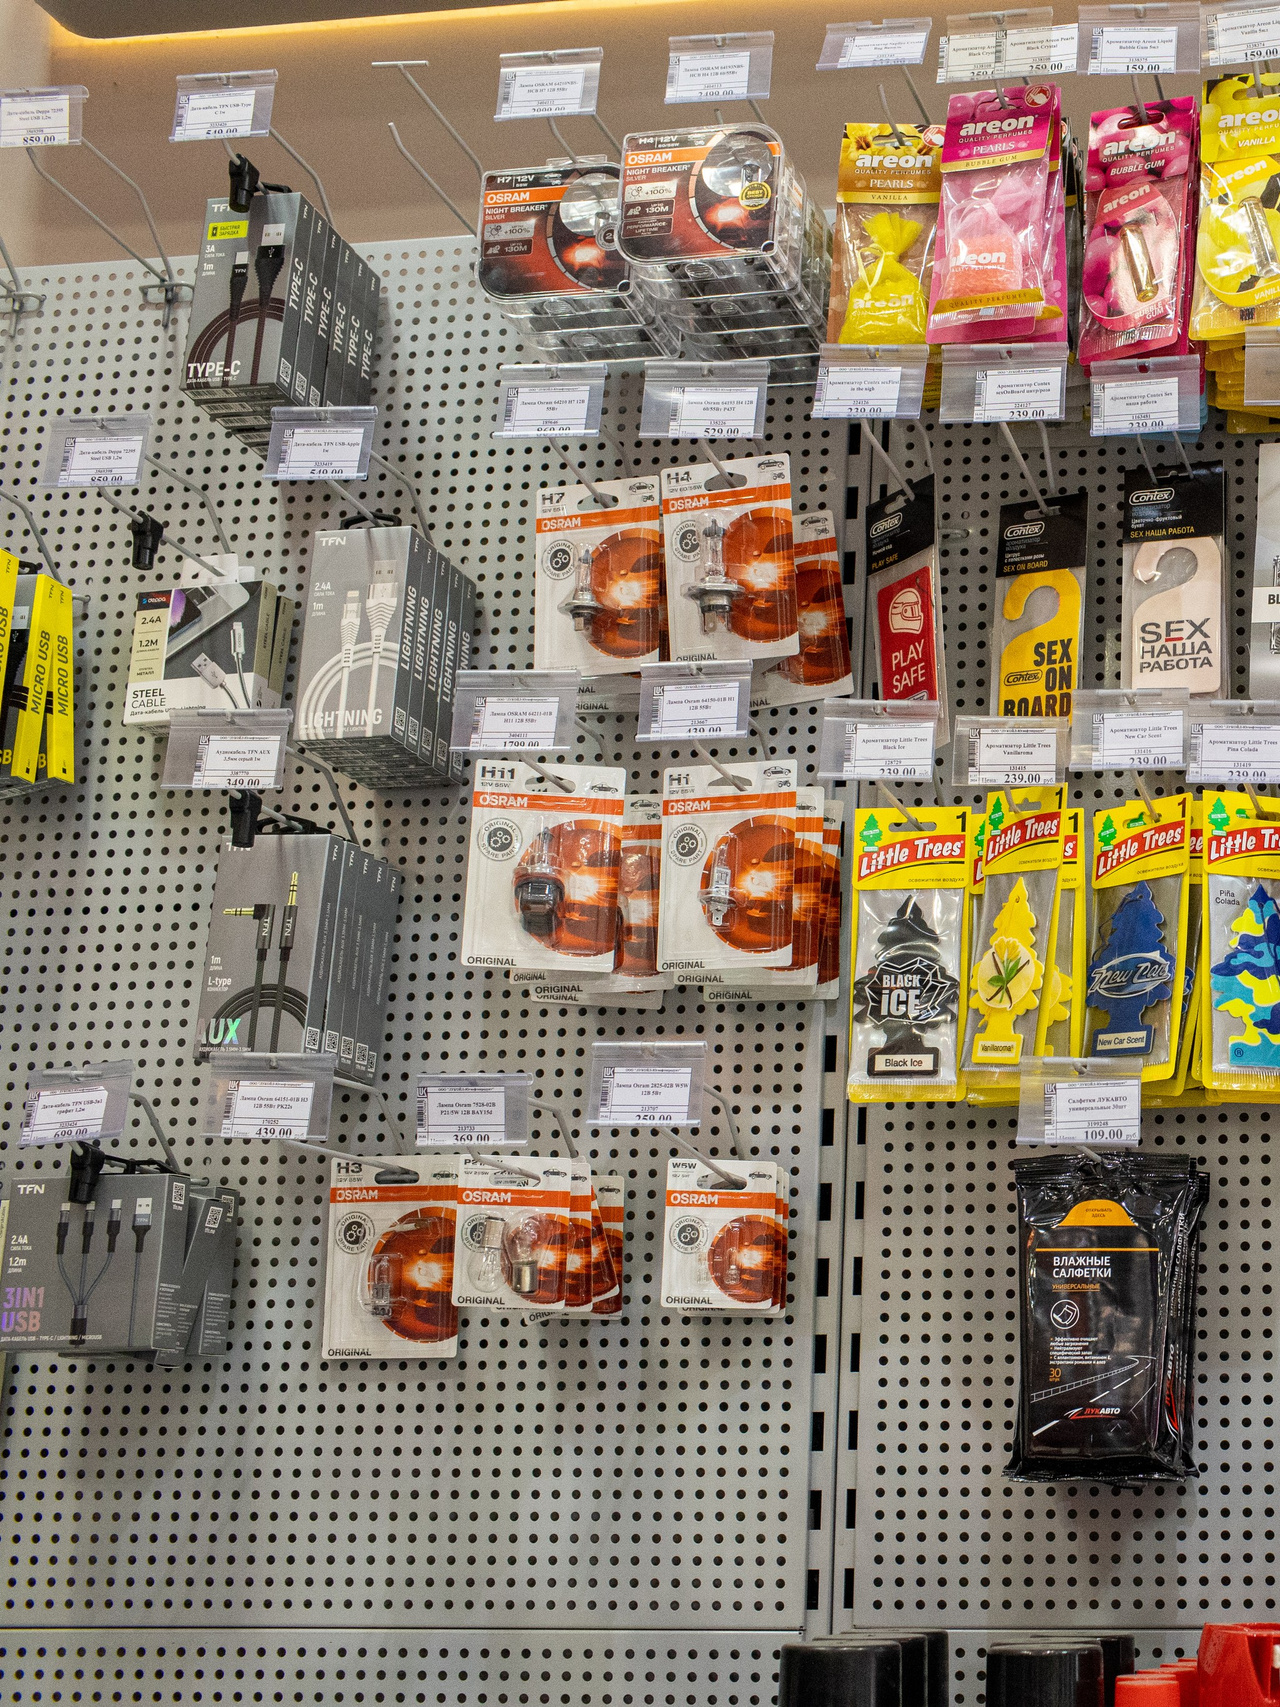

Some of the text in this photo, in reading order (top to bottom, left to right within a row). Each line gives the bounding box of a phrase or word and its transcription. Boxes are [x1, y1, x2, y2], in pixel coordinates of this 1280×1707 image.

[1244, 49, 1278, 61] 159.00
[1126, 64, 1160, 72] 159.00
[960, 115, 1034, 136] areon
[23, 134, 55, 145] 859.00
[1103, 131, 1176, 156] areon
[1238, 137, 1276, 147] VANILLA
[973, 141, 1015, 154] PEARLS
[628, 153, 672, 164] OSRAM
[856, 154, 932, 168] areon
[1217, 160, 1267, 188] areon
[870, 178, 913, 188] PEARLS
[487, 192, 530, 203] OSRAM
[289, 258, 304, 309] TYPE-C
[304, 273, 318, 324] TYPE-C
[188, 361, 240, 378] TYPE-C
[1009, 410, 1045, 419] 239.00
[704, 427, 739, 438] 529.00
[668, 472, 692, 484] H4
[542, 493, 564, 505] H7
[670, 497, 709, 511] OSRAM
[542, 517, 581, 528] OSRAM
[320, 536, 347, 546] TFN
[401, 586, 417, 670] LIGHTNING
[1140, 619, 1210, 641] SEX
[414, 597, 430, 680] LIGHTNING
[892, 641, 925, 667] PLAY
[1034, 639, 1072, 666] SEX
[1141, 641, 1212, 657] НАША
[1140, 657, 1213, 673] РАБОТА
[30, 631, 52, 714] MICRO USB
[1045, 667, 1072, 690] ON
[893, 669, 926, 693] SAFE
[133, 688, 164, 699] STEEL
[131, 698, 166, 709] CABLE
[300, 709, 383, 728] LIGHTNING
[481, 766, 515, 780] H11
[226, 777, 259, 788] 349.00
[479, 795, 528, 807] OSRAM
[668, 801, 711, 812] OSRAM
[987, 818, 1057, 860] Little Trees
[1098, 826, 1181, 876] Little Trees
[860, 839, 961, 877] Little Trees
[1219, 890, 1235, 898] Piña
[1215, 898, 1240, 906] Colada
[467, 957, 517, 966] ORIGINAL
[662, 961, 705, 970] ORIGINAL
[882, 975, 920, 988] BLACK
[709, 991, 752, 999] ORIGINAL
[884, 1058, 923, 1068] Black Ice
[256, 1127, 292, 1139] 439.00
[452, 1133, 490, 1145] 369.00
[1084, 1129, 1123, 1141] 109.00
[337, 1162, 362, 1173] H3
[671, 1162, 697, 1171] W5W
[18, 1184, 45, 1194] TFN
[1053, 1256, 1110, 1267] ВЛАЖНЫЕ
[1052, 1267, 1112, 1279] САЛФЕТКИ
[5, 1287, 44, 1308] 3IN1
[457, 1296, 505, 1305] ORIGINAL
[1, 1311, 41, 1332] USB
[328, 1348, 371, 1356] ORIGINAL
[1049, 1368, 1062, 1378] 30
